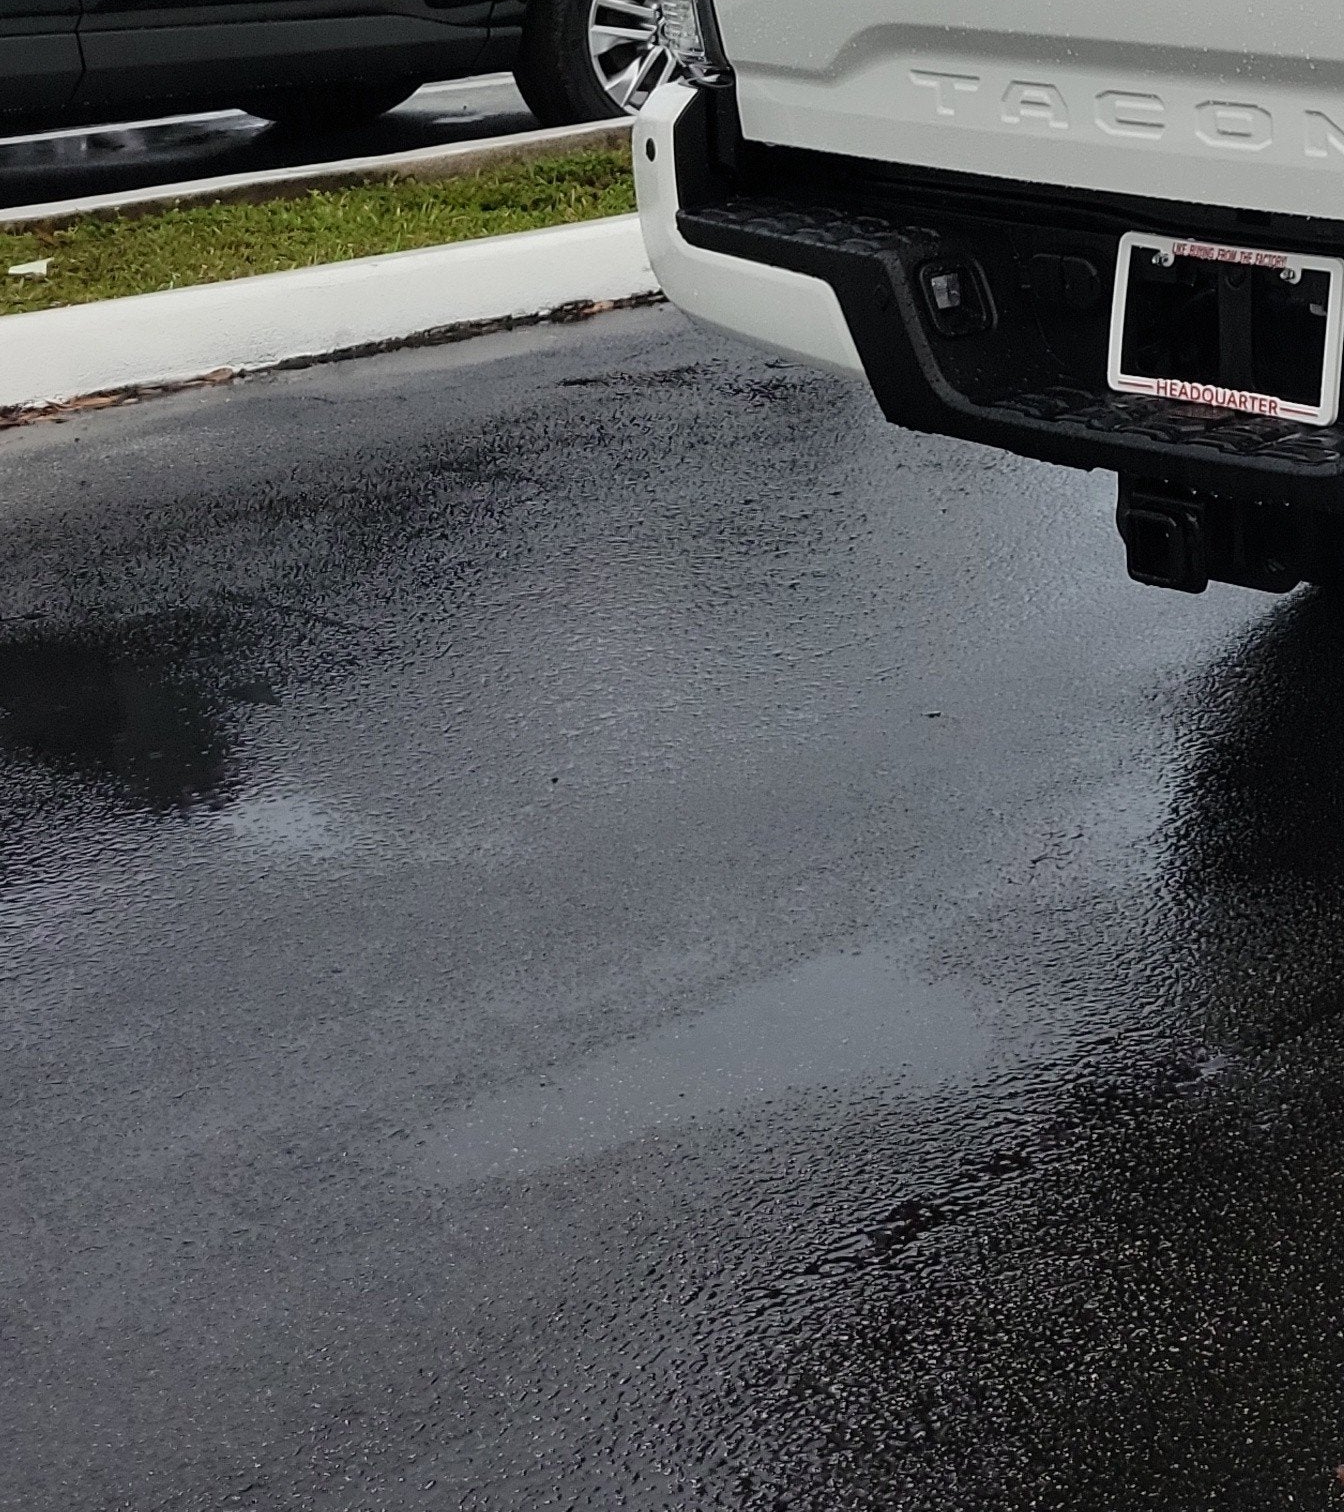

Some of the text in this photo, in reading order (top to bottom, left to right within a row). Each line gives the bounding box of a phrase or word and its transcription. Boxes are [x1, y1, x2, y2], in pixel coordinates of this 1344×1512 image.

[1217, 248, 1237, 261] FROM
[1240, 251, 1253, 263] THE
[1157, 380, 1279, 415] HEADQUARTER
